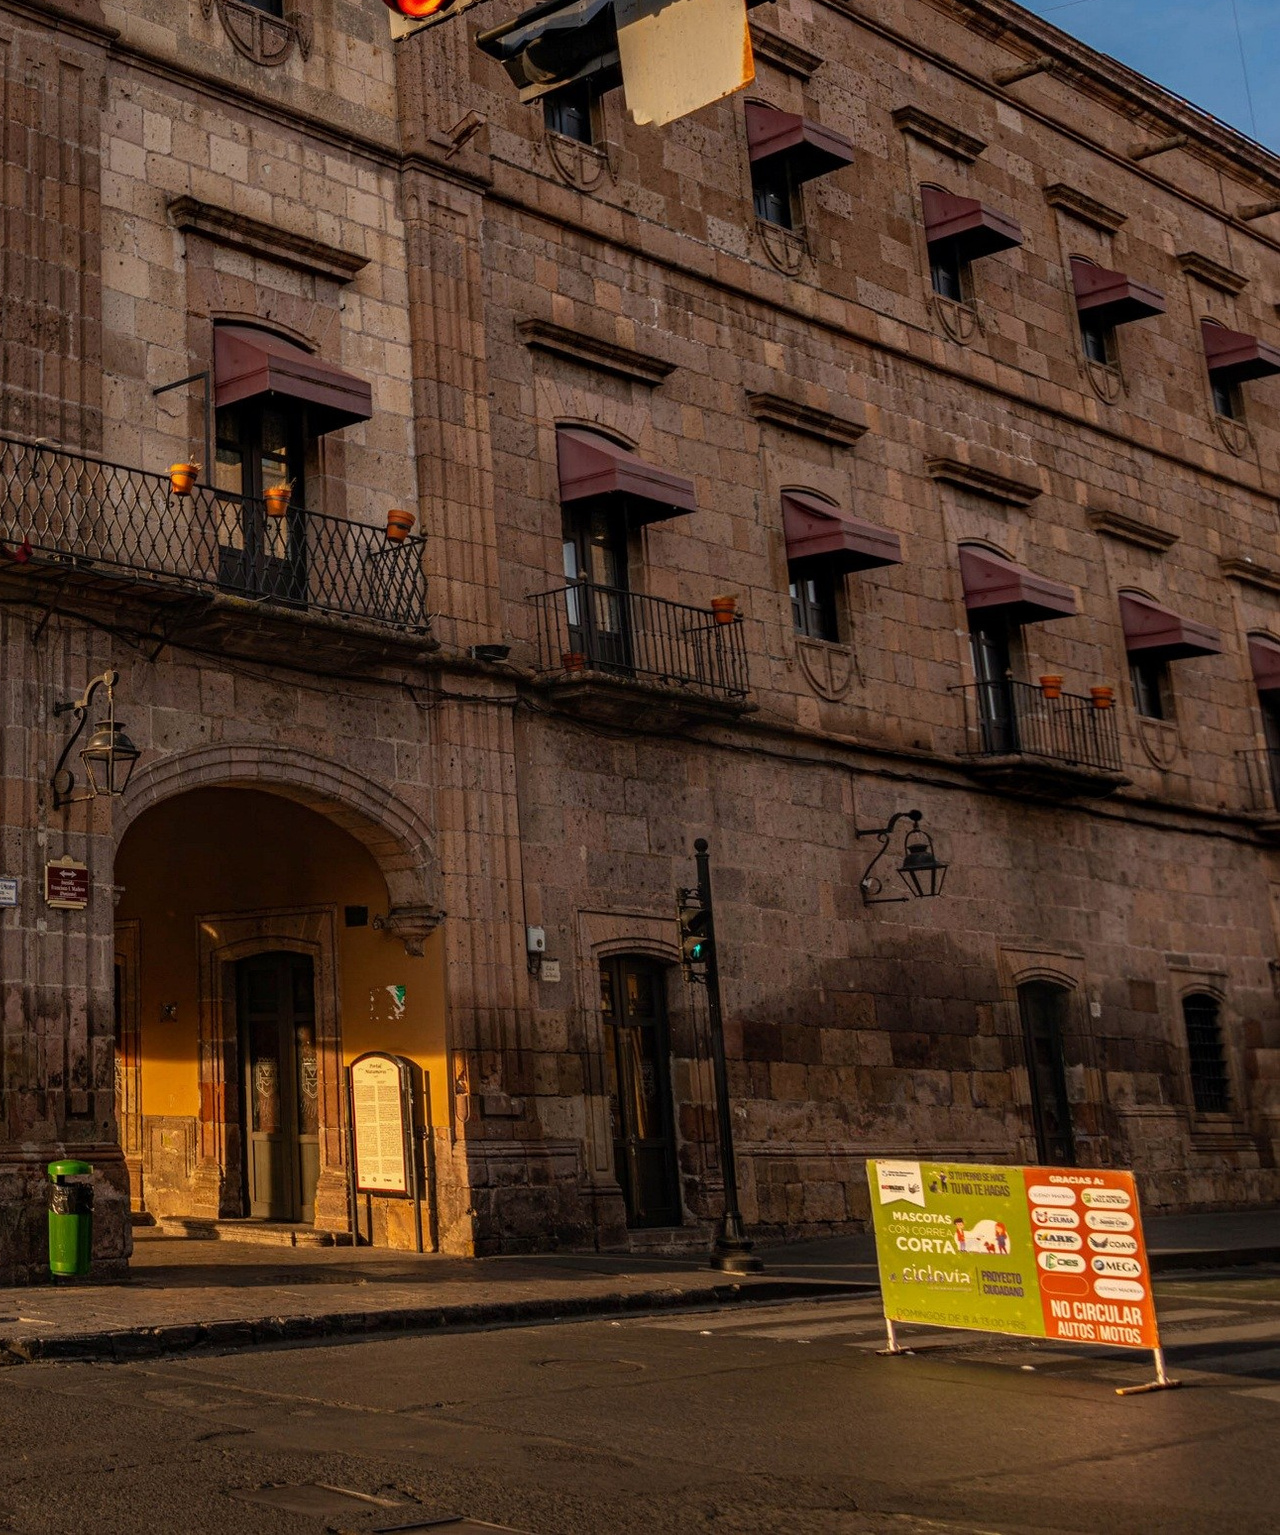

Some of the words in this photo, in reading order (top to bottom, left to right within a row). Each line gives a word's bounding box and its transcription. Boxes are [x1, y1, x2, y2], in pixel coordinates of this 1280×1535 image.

[1048, 1175, 1091, 1184] GRACIAS
[1093, 1177, 1104, 1185] A:
[951, 1183, 961, 1194] TU
[961, 1183, 973, 1195] NO
[973, 1184, 983, 1195] TE
[984, 1184, 1011, 1197] HAGAS
[892, 1211, 952, 1225] MASCOTAS
[888, 1224, 909, 1234] CON
[911, 1226, 954, 1237] CORREA
[896, 1236, 956, 1255] CORTA
[1109, 1241, 1136, 1249] COAVE
[1106, 1261, 1140, 1272] MEGA
[981, 1270, 1023, 1284] PROYECTO
[983, 1284, 1024, 1297] CIUDADANO
[896, 1308, 947, 1321] DOMINGOS
[1050, 1299, 1071, 1318] NO
[1072, 1301, 1143, 1326] CIRCULAR
[1058, 1321, 1095, 1340] AUTOS
[1100, 1324, 1142, 1344] MOTOS
